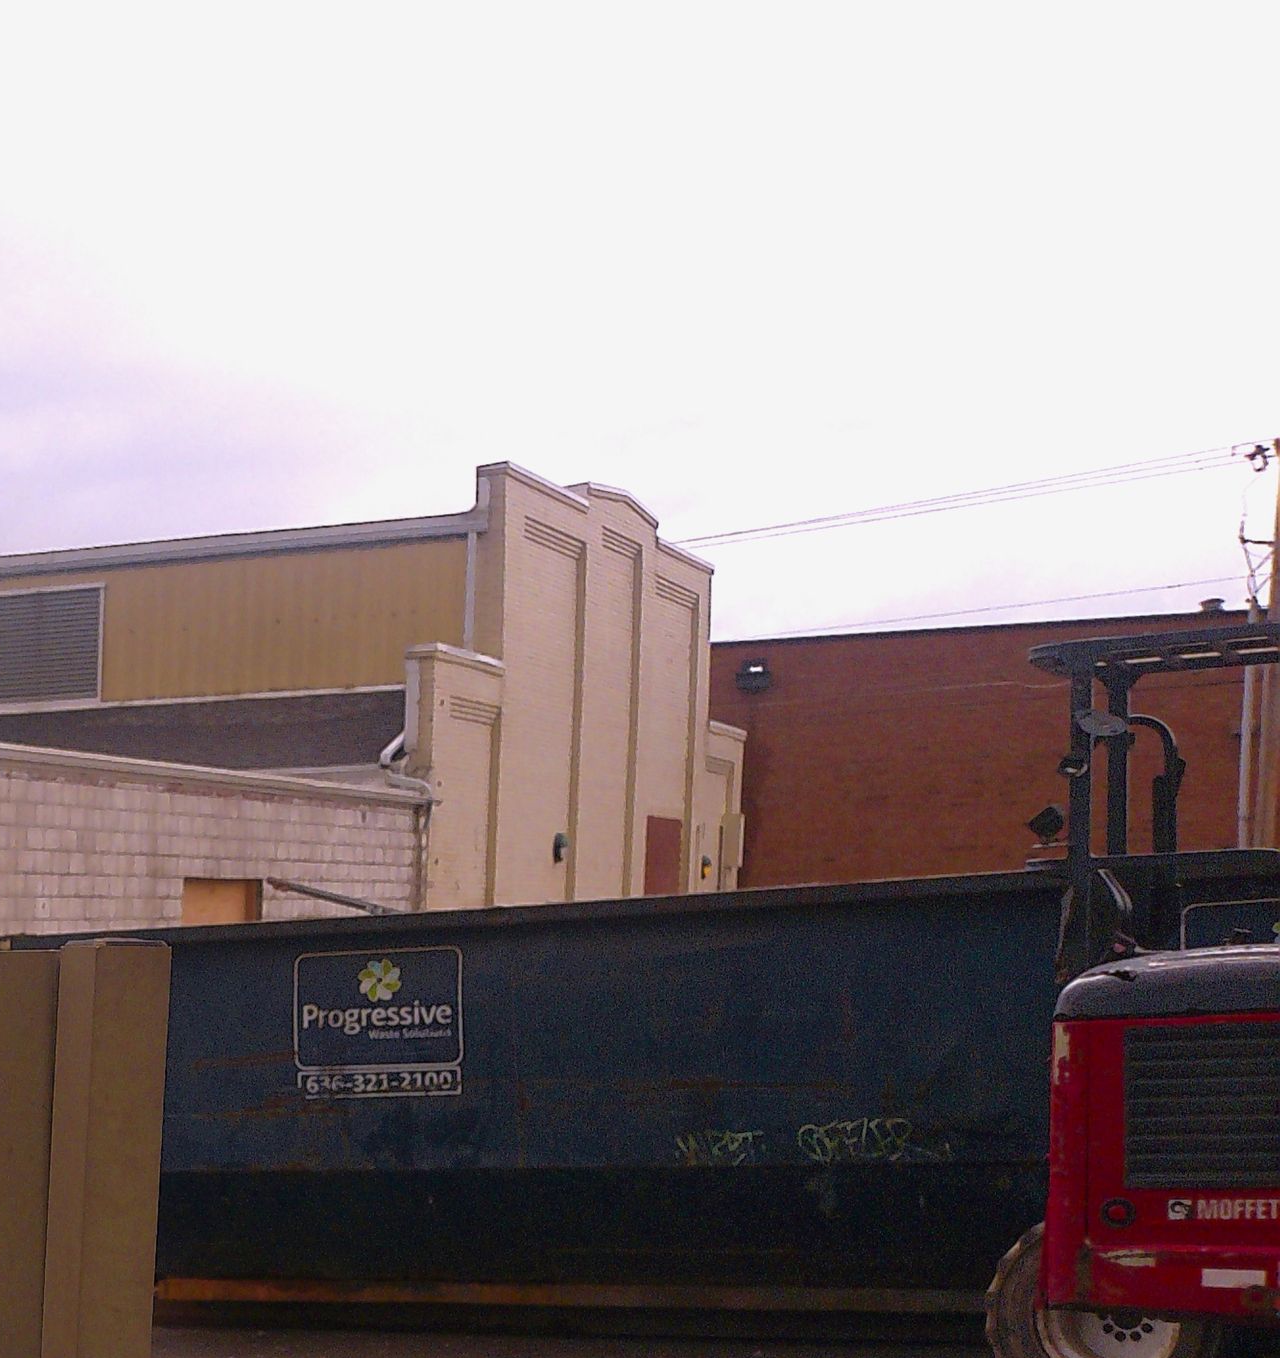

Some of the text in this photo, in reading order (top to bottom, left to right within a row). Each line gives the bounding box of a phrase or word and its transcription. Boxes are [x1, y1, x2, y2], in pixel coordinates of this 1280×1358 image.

[302, 999, 453, 1035] Progressive
[305, 1071, 453, 1093] 636-321-2100
[1197, 1199, 1280, 1220] MOFFET
